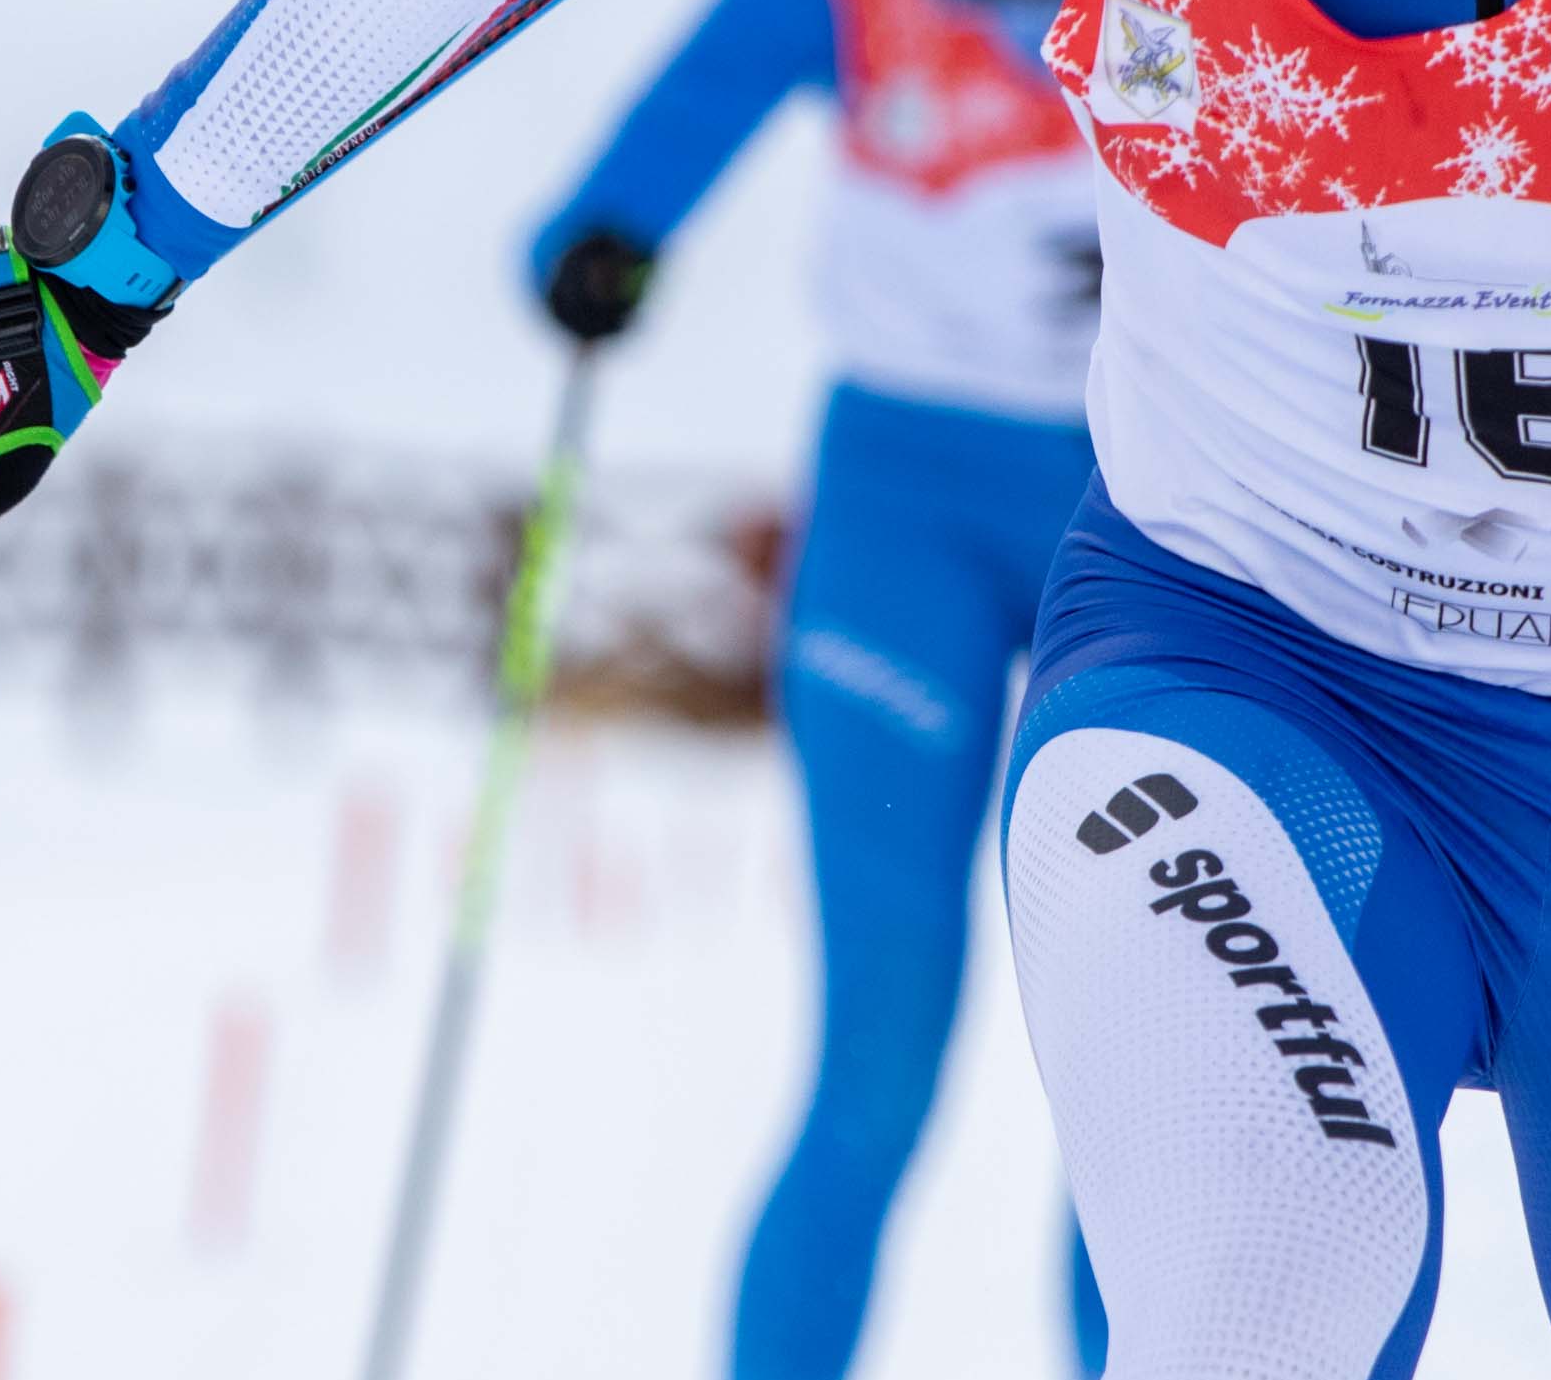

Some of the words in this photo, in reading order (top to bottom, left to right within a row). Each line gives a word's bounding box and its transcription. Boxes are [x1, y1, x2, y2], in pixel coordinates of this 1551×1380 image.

[1344, 290, 1467, 310] Formazza
[1351, 545, 1545, 601] COSTRUZIONI
[1148, 848, 1398, 1150] sportful
